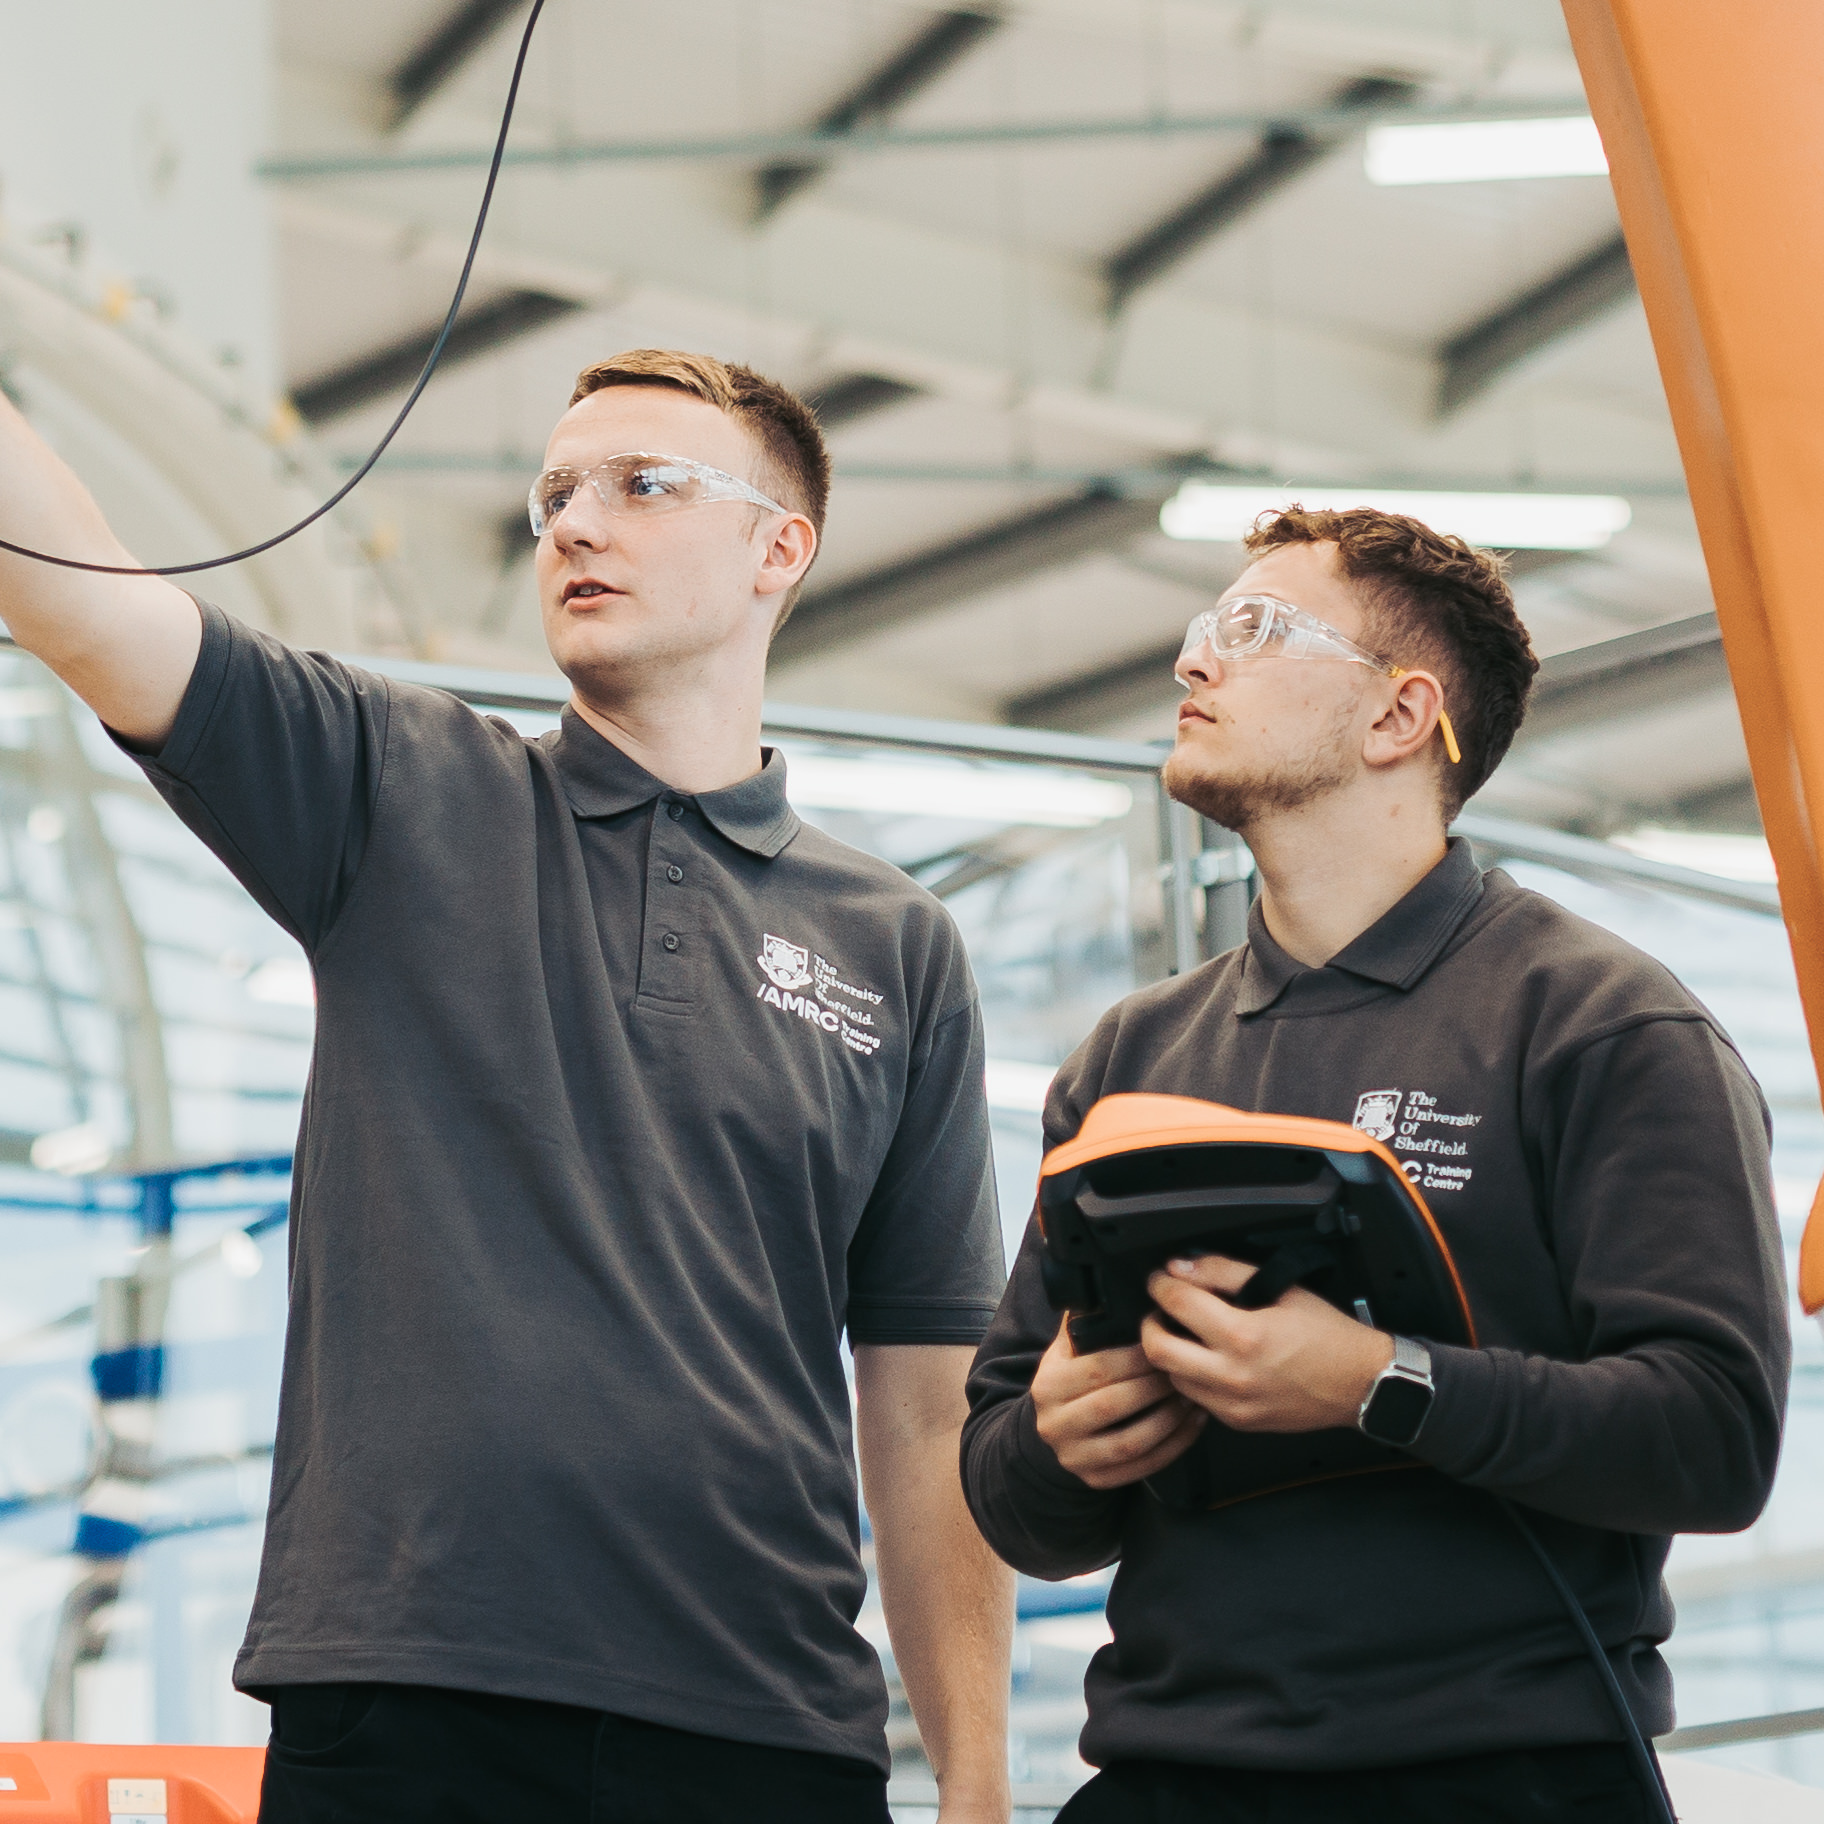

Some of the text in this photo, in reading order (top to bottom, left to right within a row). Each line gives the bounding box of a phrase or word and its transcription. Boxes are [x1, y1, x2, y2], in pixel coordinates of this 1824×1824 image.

[813, 953, 838, 976] The
[813, 964, 884, 1005] University
[840, 1030, 873, 1056] Centre
[841, 1020, 881, 1049] Training
[1408, 1090, 1438, 1107] The
[1404, 1105, 1483, 1127] University
[1399, 1121, 1421, 1136] Of
[1426, 1162, 1473, 1181] Training
[1423, 1175, 1464, 1191] Centre
